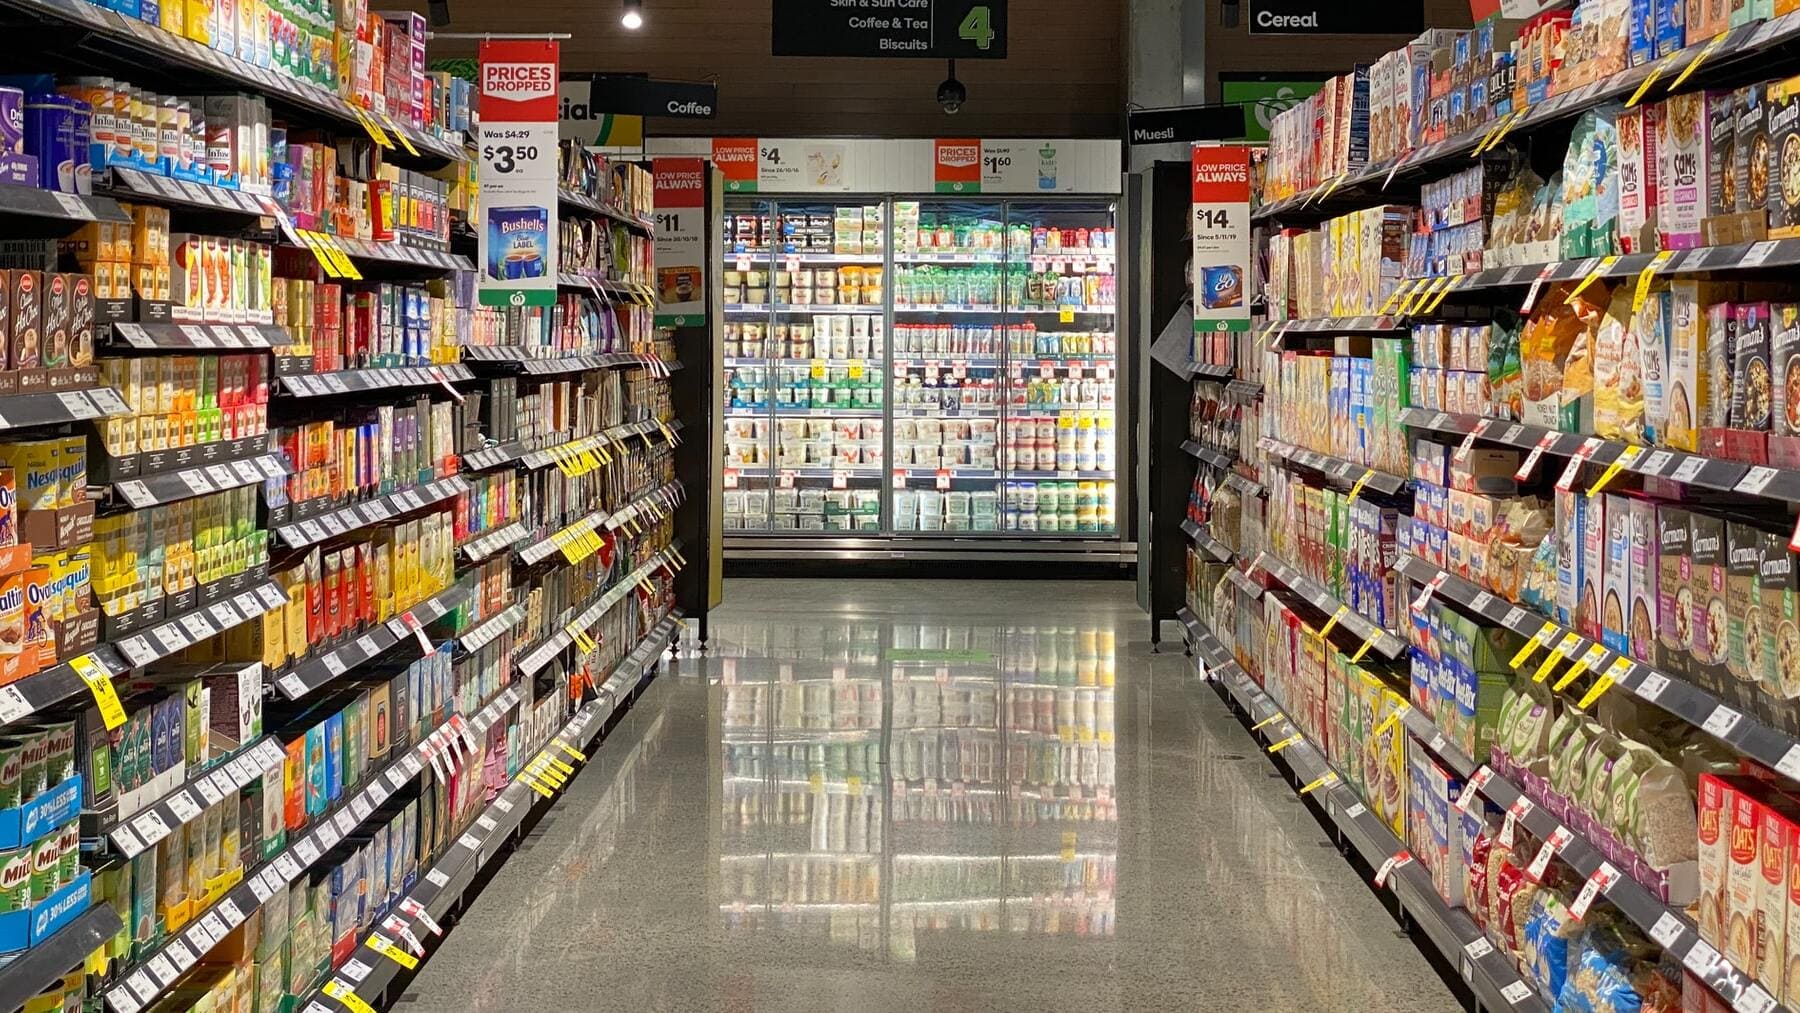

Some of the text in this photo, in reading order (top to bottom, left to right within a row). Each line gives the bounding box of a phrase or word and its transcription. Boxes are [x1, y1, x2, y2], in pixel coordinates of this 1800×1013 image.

[848, 16, 928, 29] Coffee & Tea
[1256, 10, 1318, 28] Cereal
[958, 6, 995, 49] 4
[879, 38, 928, 50] Biscuits
[486, 67, 551, 80] PRICES
[486, 81, 551, 92] DROPPED
[667, 100, 711, 115] Coffee
[505, 131, 530, 139] $4.29
[1134, 127, 1175, 141] Muesli
[715, 153, 756, 162] ALWAYS
[761, 147, 781, 165] $4
[940, 148, 977, 156] PRICES
[655, 172, 675, 180] LOW
[1196, 172, 1247, 183] ALWAYS
[655, 179, 702, 190] ALWAYS
[501, 217, 544, 234] Bushells
[656, 214, 679, 231] $11
[1197, 209, 1229, 229] $14
[1700, 808, 1718, 829] OATS
[1732, 825, 1755, 853] OATS
[1763, 842, 1783, 869] OATS
